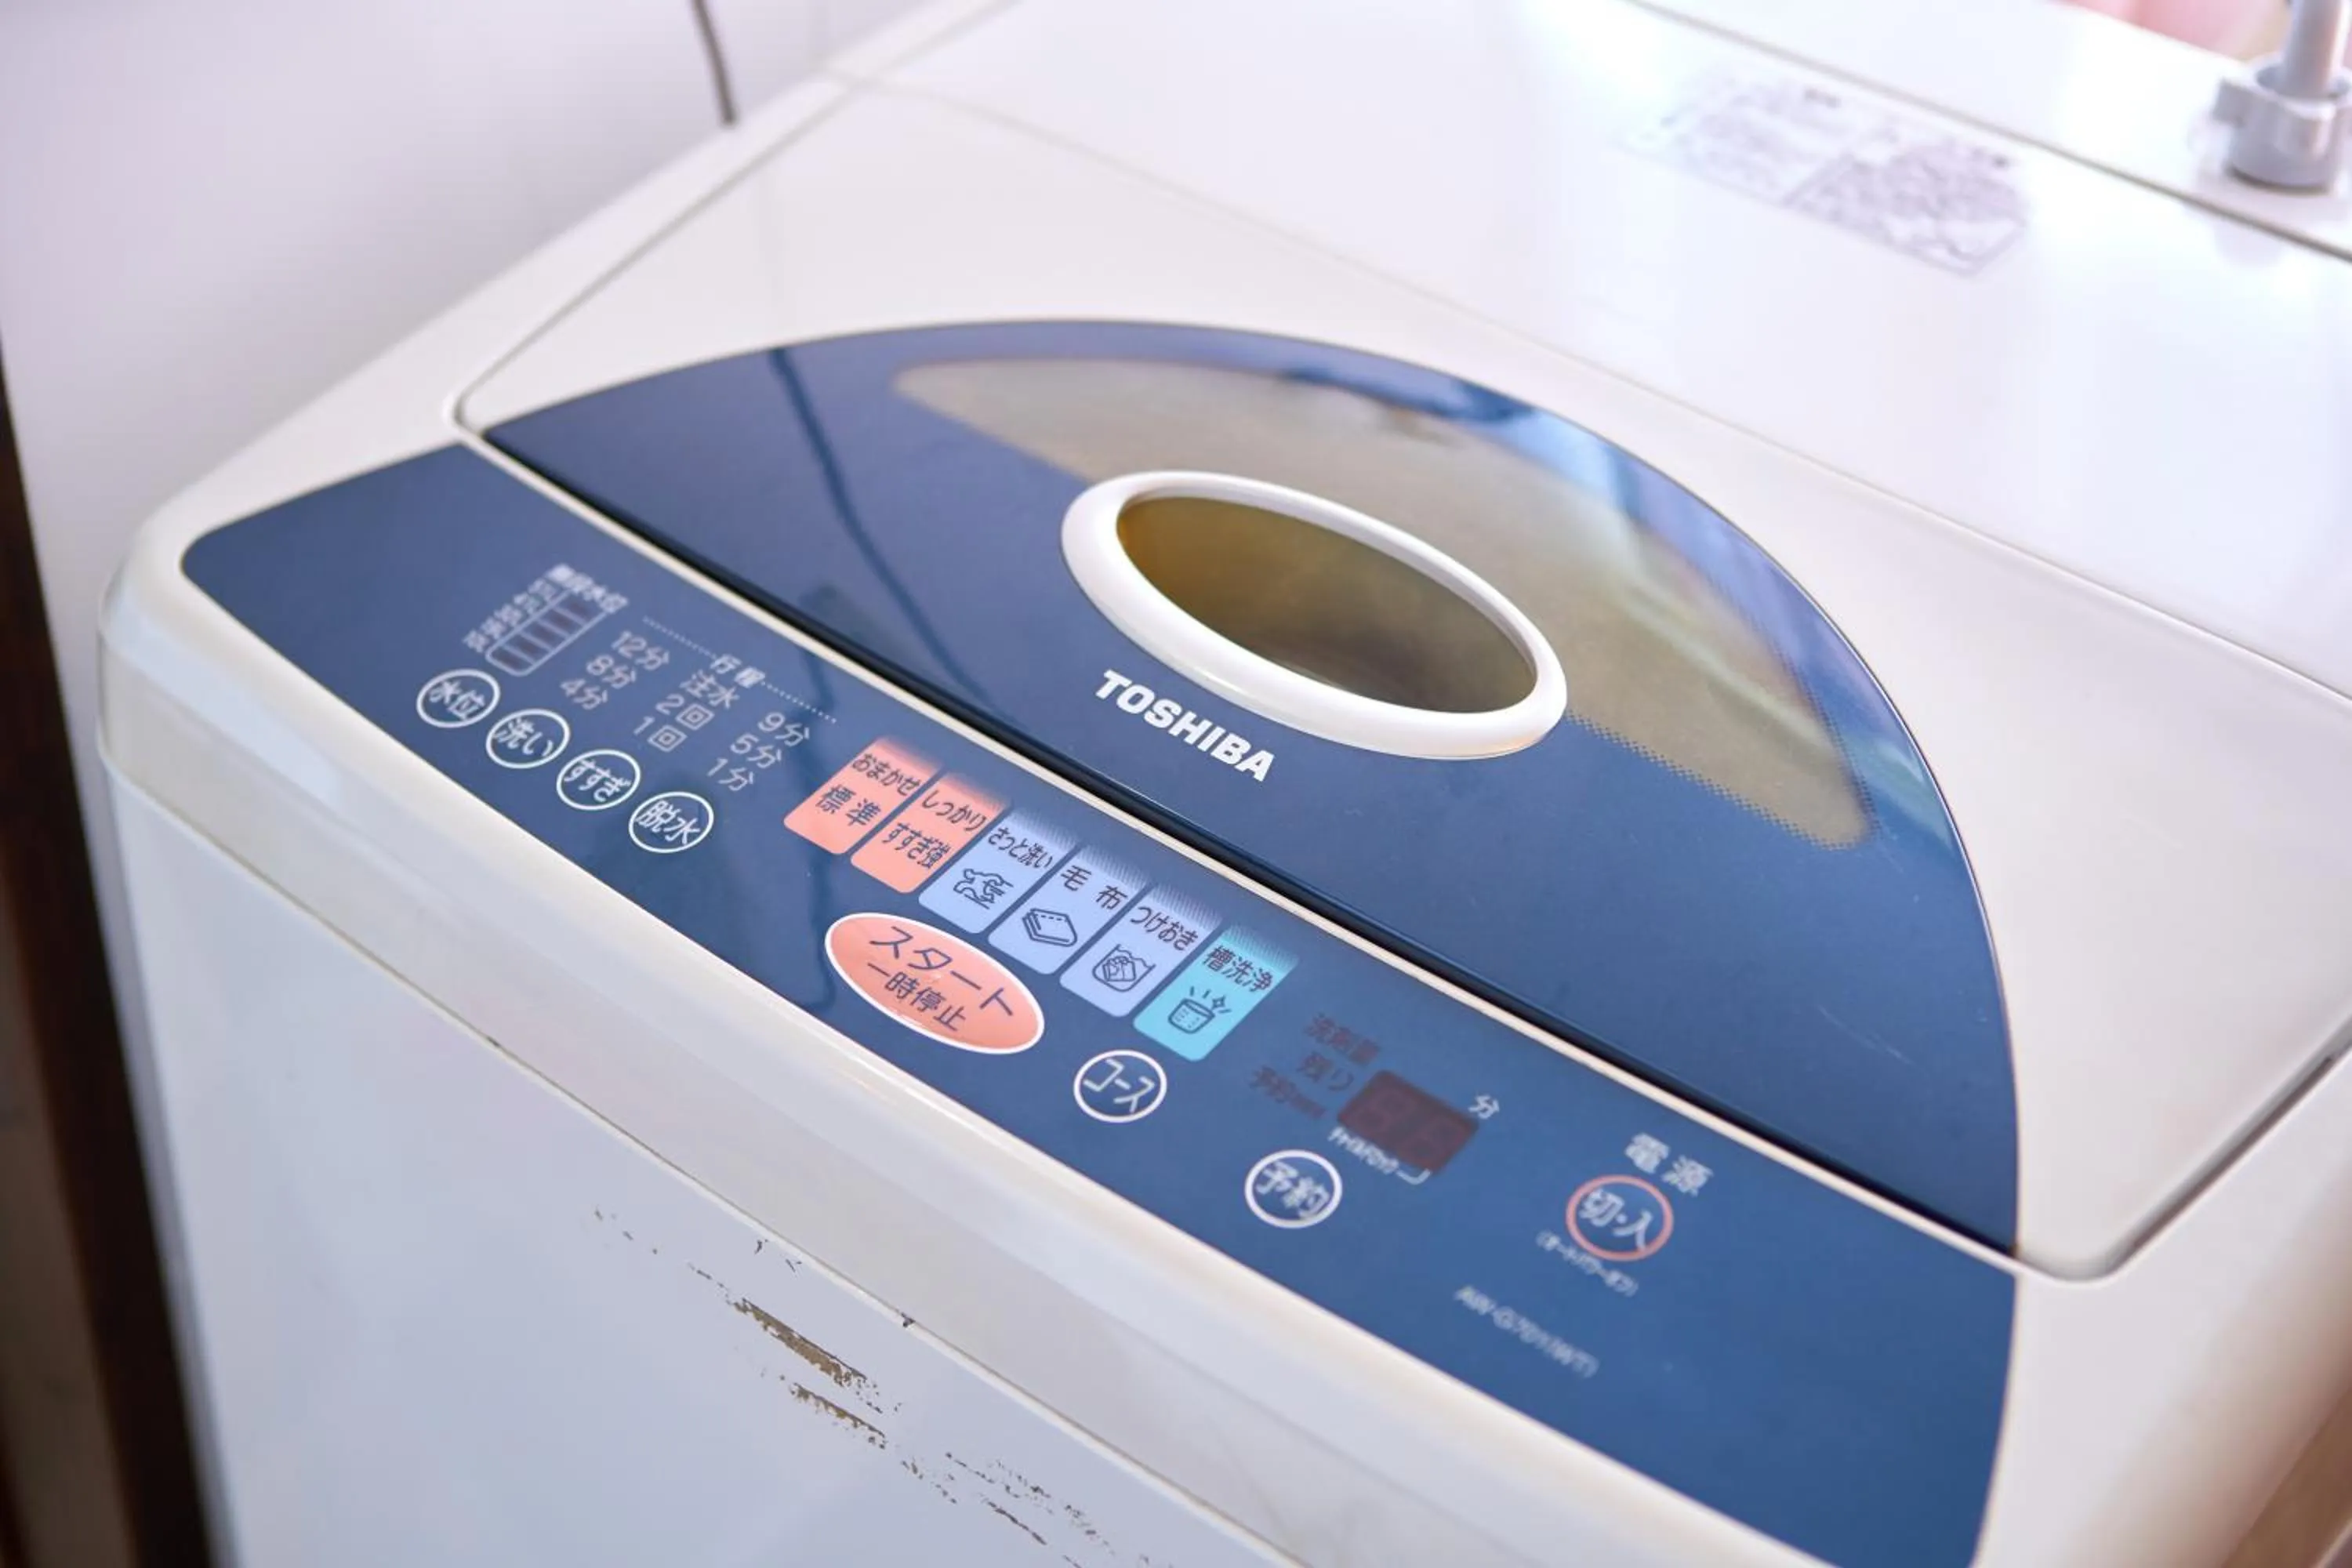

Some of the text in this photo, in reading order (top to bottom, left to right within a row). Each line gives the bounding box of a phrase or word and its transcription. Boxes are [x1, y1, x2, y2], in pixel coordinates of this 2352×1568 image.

[585, 654, 637, 689] 8分
[609, 630, 670, 672] 12分
[429, 679, 486, 719] 水位
[559, 678, 608, 711] 4分
[681, 670, 739, 709] 注水
[632, 715, 688, 753] 1回
[655, 695, 714, 731] 2回
[757, 712, 811, 748] 9分
[1095, 669, 1276, 782] TOSHIBA
[492, 717, 554, 757] 洗い
[729, 734, 782, 771] 5分
[563, 757, 632, 802] すすぎ
[707, 757, 755, 793] 1分
[849, 753, 921, 797] おまかせ
[636, 800, 700, 846] 脱水
[815, 783, 882, 827] 標準
[921, 789, 988, 833] しっかり
[882, 823, 950, 870] すすぎ強
[987, 826, 1052, 870] さっと洗い
[1061, 865, 1129, 911] 毛布
[1129, 906, 1200, 951] つけおき
[869, 925, 1014, 1019] スタート
[1203, 946, 1276, 993] 槽洗浄
[866, 961, 967, 1033] 一時停止
[1083, 1058, 1156, 1114] コース
[1624, 1131, 1714, 1197] 電源
[1254, 1161, 1331, 1218] 予約
